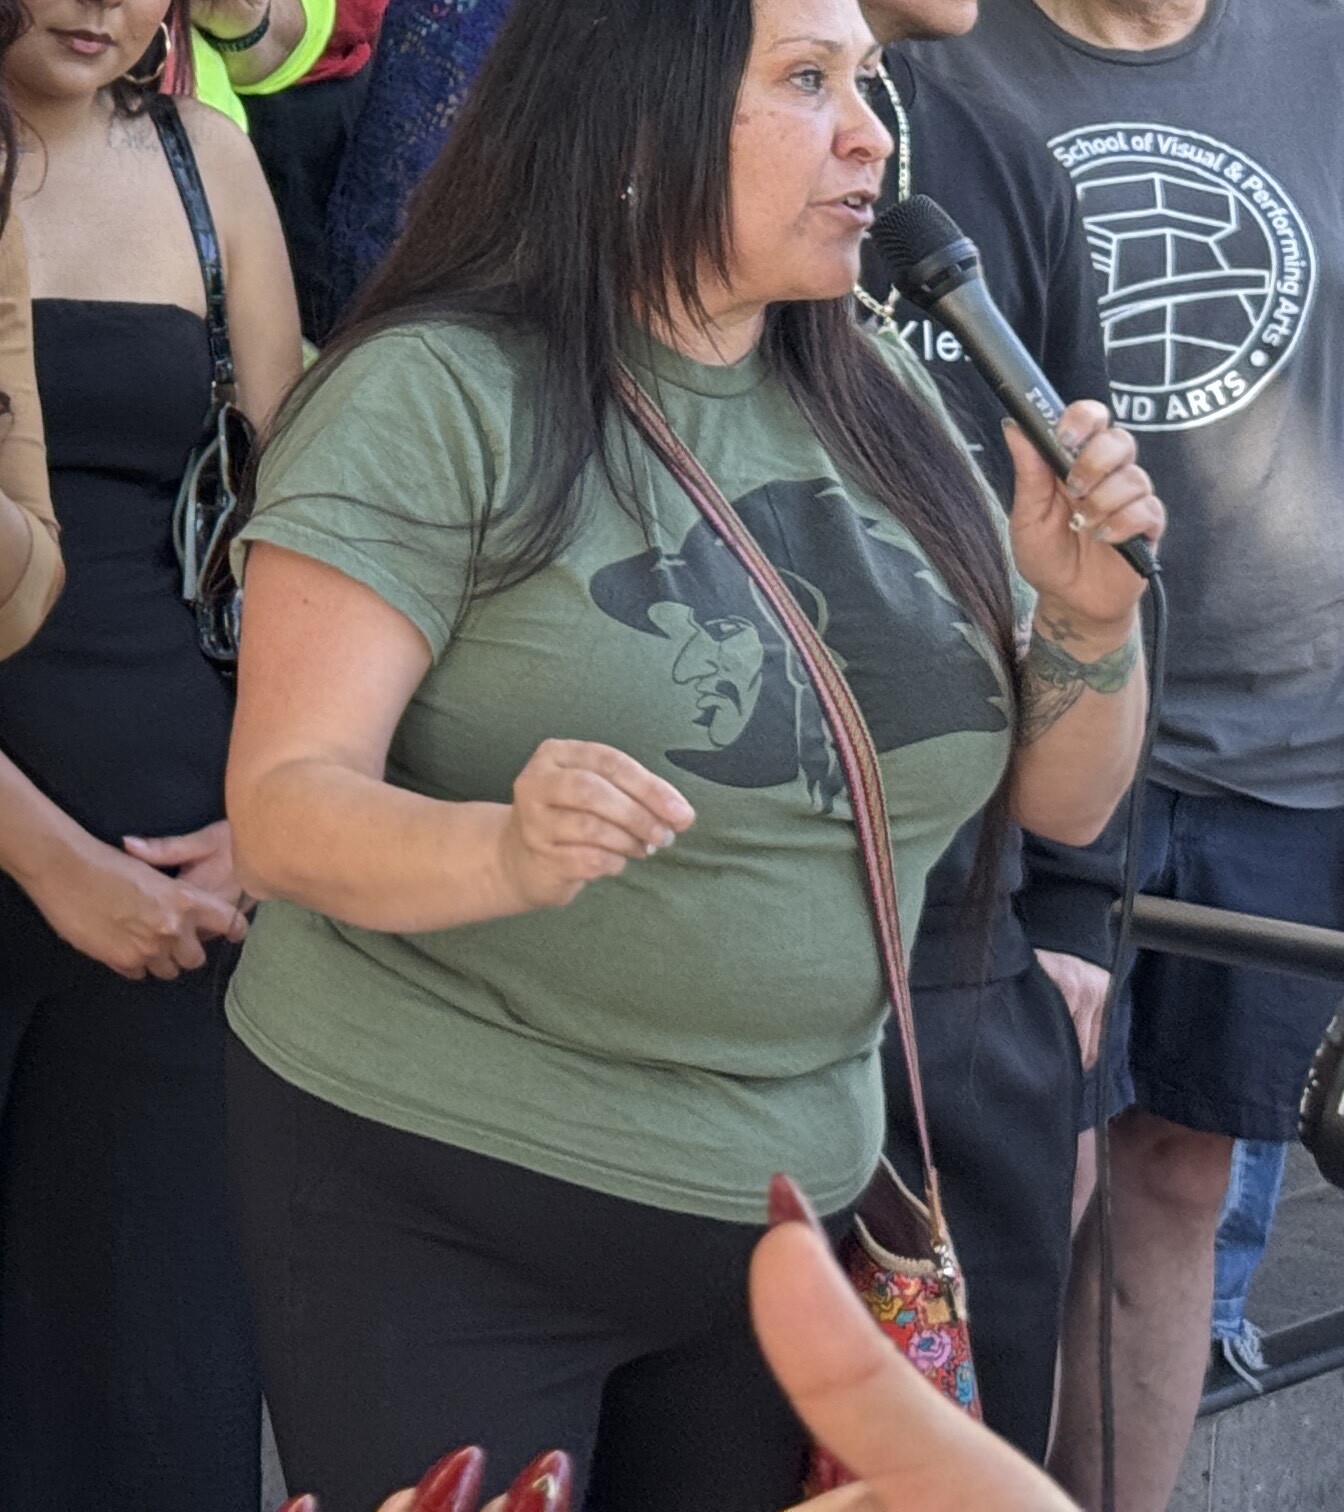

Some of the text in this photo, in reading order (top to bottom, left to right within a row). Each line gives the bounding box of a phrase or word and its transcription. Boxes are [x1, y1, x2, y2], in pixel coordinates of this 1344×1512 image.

[1053, 131, 1306, 347] School of Visual & Performing Arts
[1109, 392, 1156, 421] ND
[1165, 370, 1247, 421] ARTS
